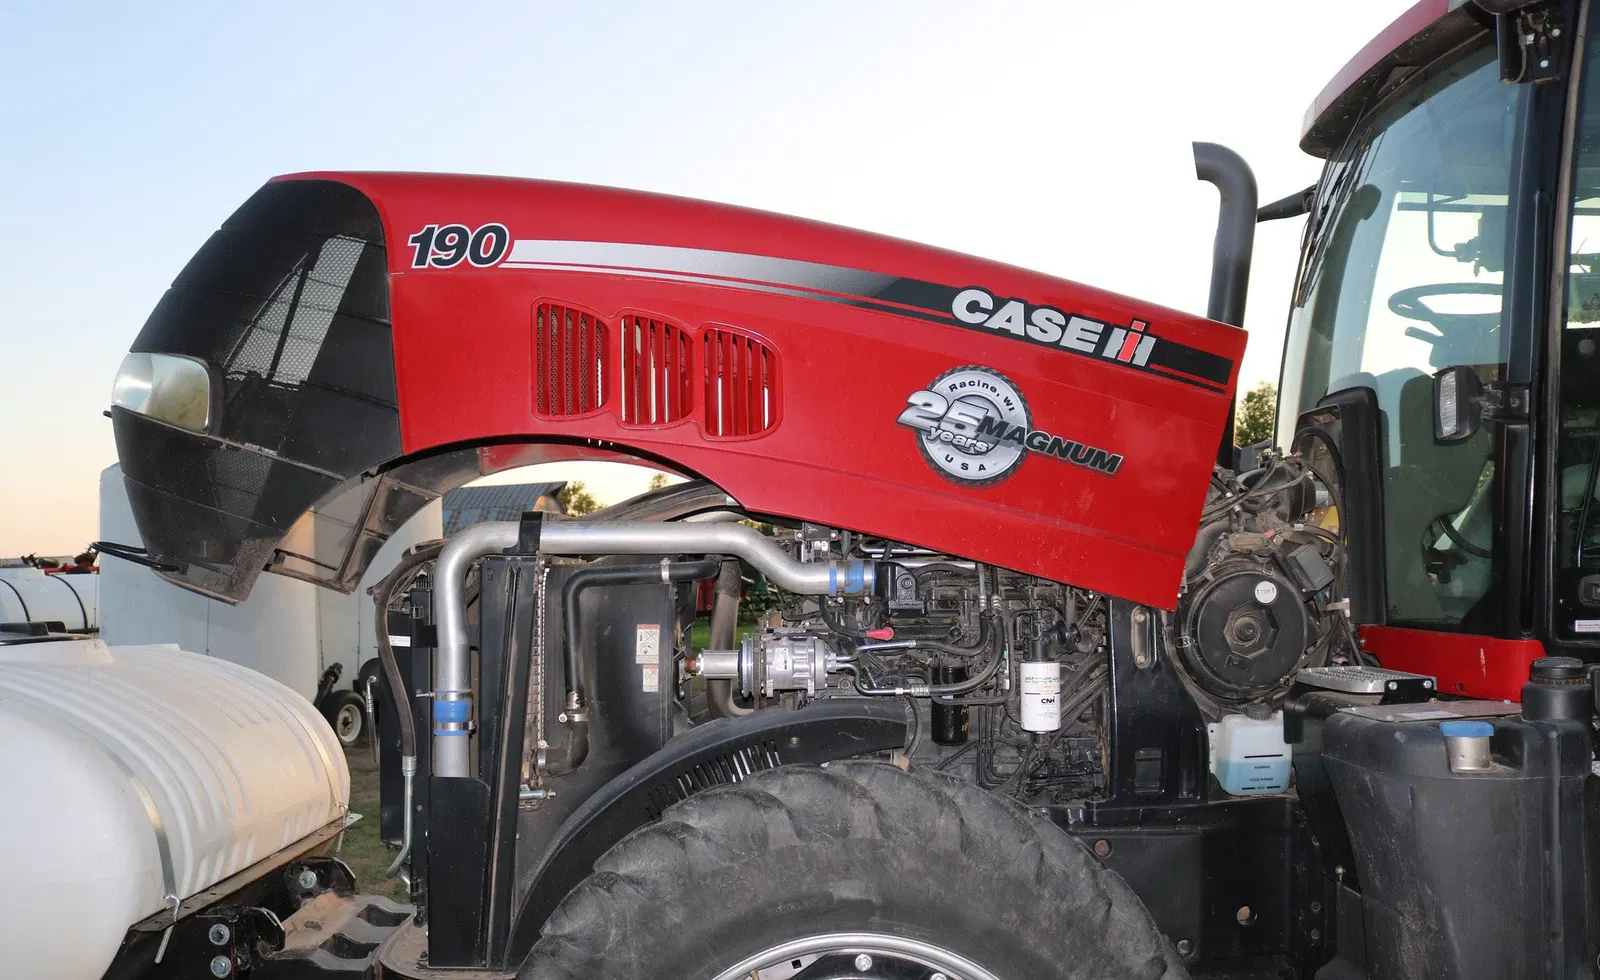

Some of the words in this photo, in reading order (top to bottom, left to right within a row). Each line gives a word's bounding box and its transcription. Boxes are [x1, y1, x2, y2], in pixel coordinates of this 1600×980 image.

[407, 222, 510, 269] 190
[951, 289, 1105, 354] CASE
[896, 389, 990, 440] 25
[948, 379, 1000, 397] Racine,
[1003, 396, 1015, 412] WI
[926, 425, 990, 454] years
[975, 414, 1124, 476] MAGNUM
[1041, 696, 1055, 704] CNH
